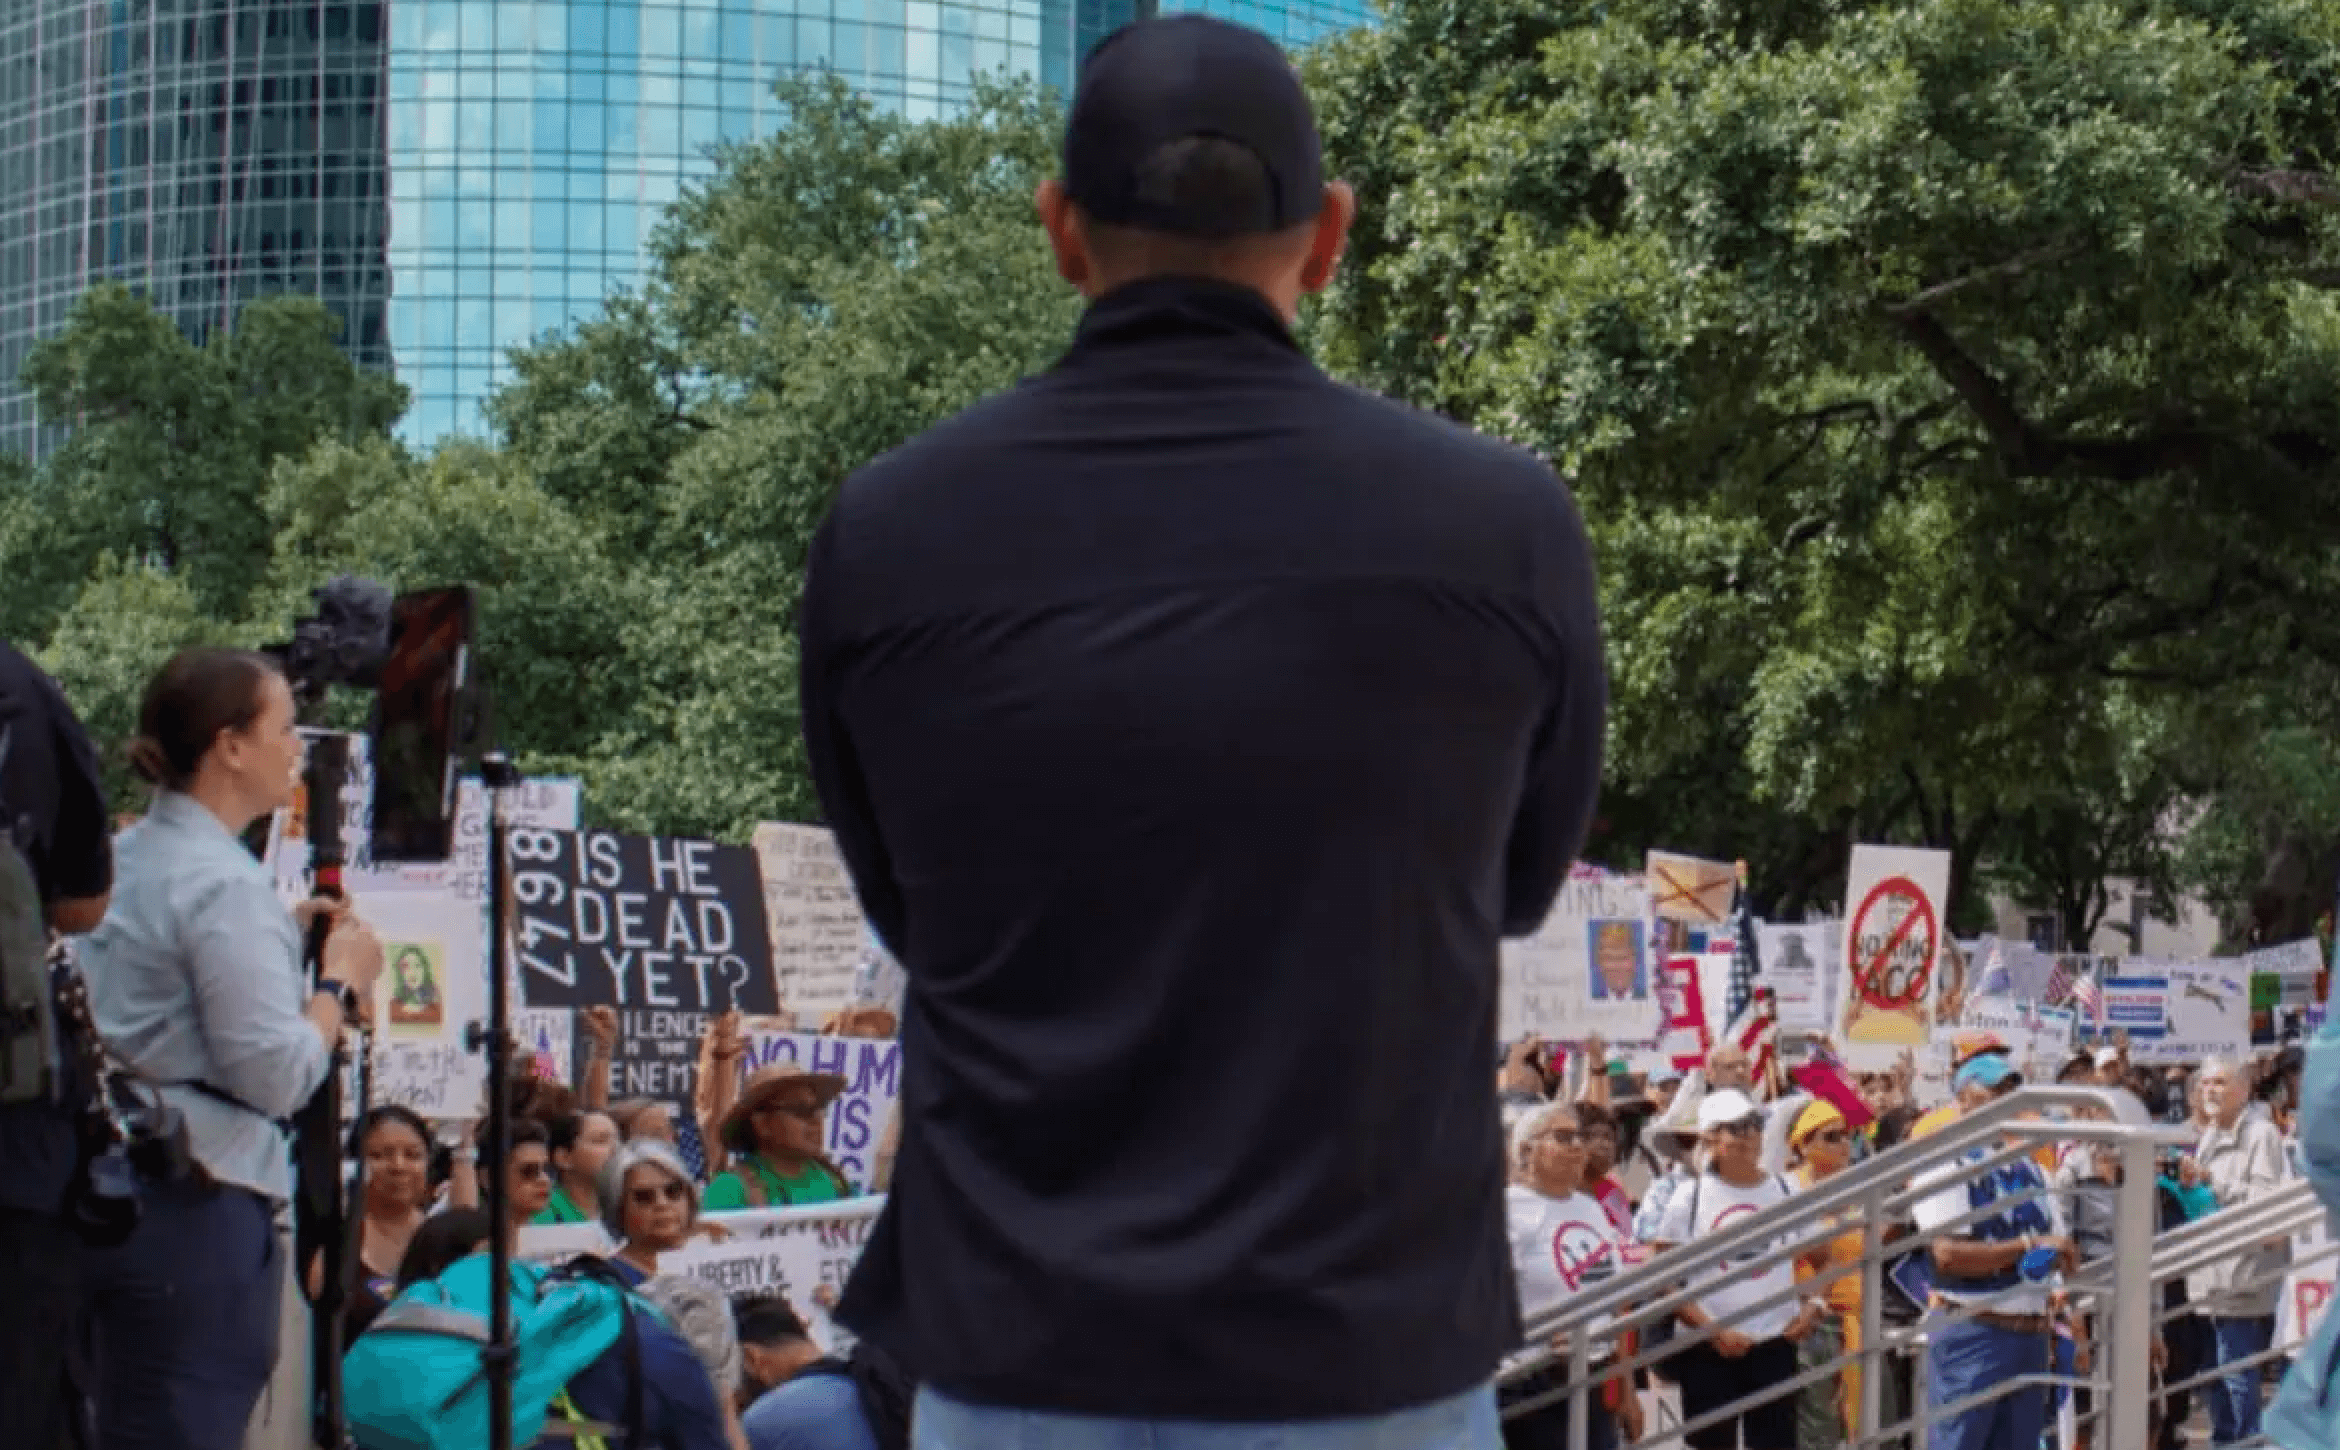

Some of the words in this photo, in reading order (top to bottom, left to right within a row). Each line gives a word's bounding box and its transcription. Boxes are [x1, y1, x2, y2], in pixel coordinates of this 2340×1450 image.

[576, 831, 622, 888] IS
[651, 837, 721, 895] HE
[508, 829, 577, 988] 8647
[573, 887, 734, 954] DEAD
[601, 947, 750, 1011] YET?
[623, 1011, 711, 1039] ILENCE
[830, 1098, 872, 1149] IS
